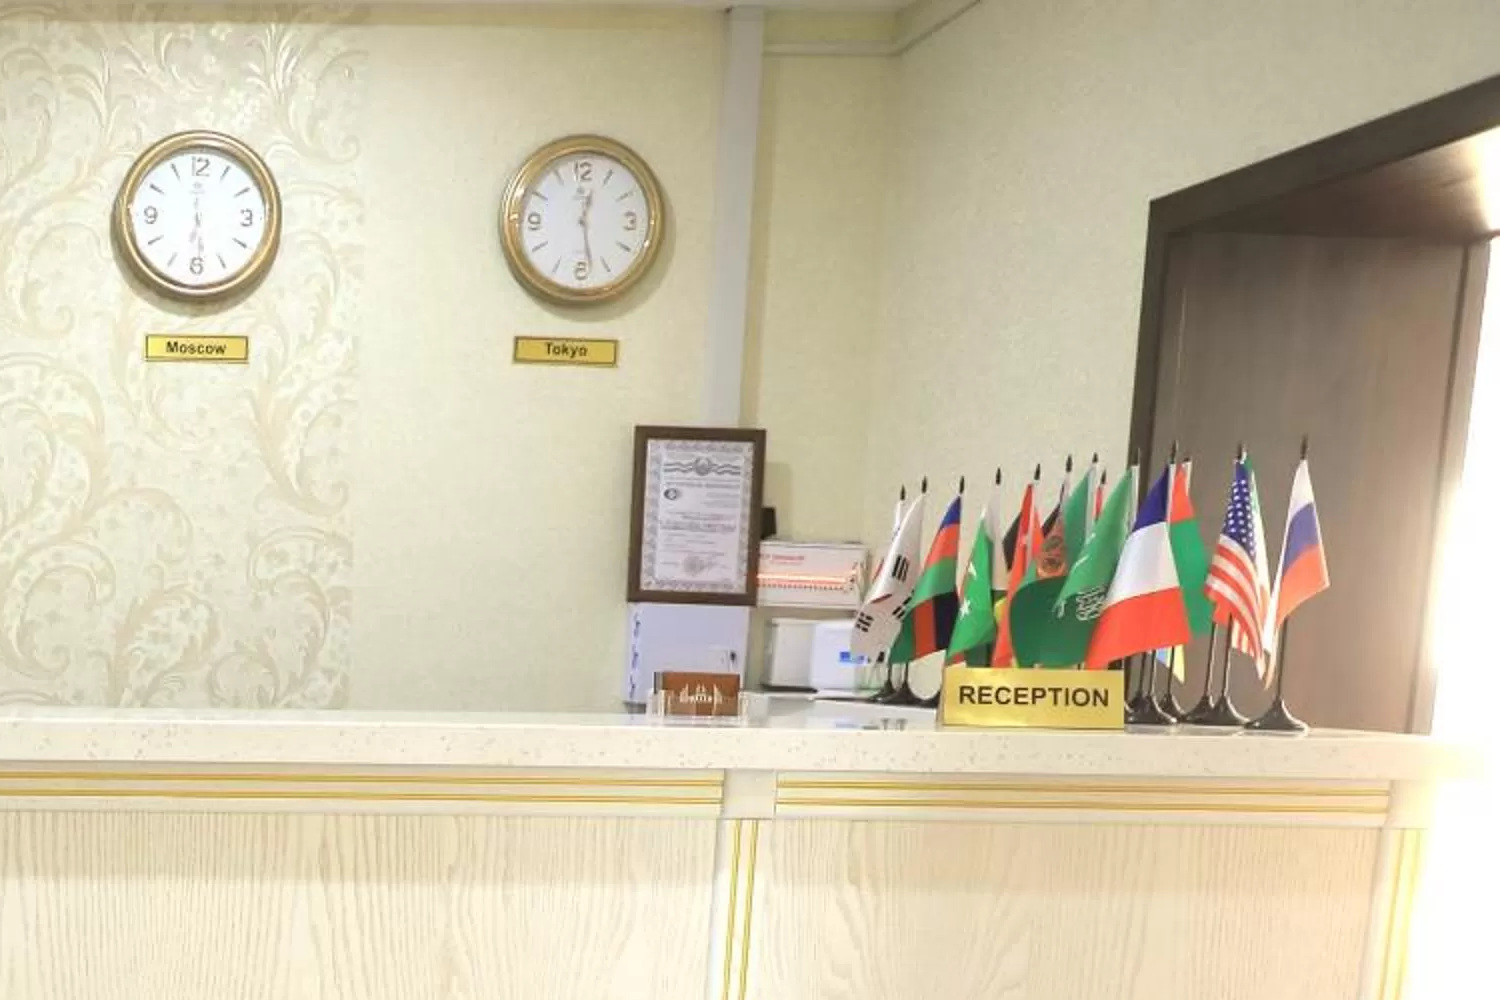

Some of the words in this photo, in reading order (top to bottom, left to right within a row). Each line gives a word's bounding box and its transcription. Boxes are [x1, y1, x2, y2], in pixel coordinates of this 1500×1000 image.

[191, 156, 210, 177] 12
[574, 161, 593, 181] 12
[143, 206, 158, 225] 9
[240, 208, 253, 227] 3
[623, 210, 637, 231] 3
[189, 256, 204, 275] 6
[166, 341, 227, 355] Moscow
[959, 685, 1109, 707] RECEPTION
